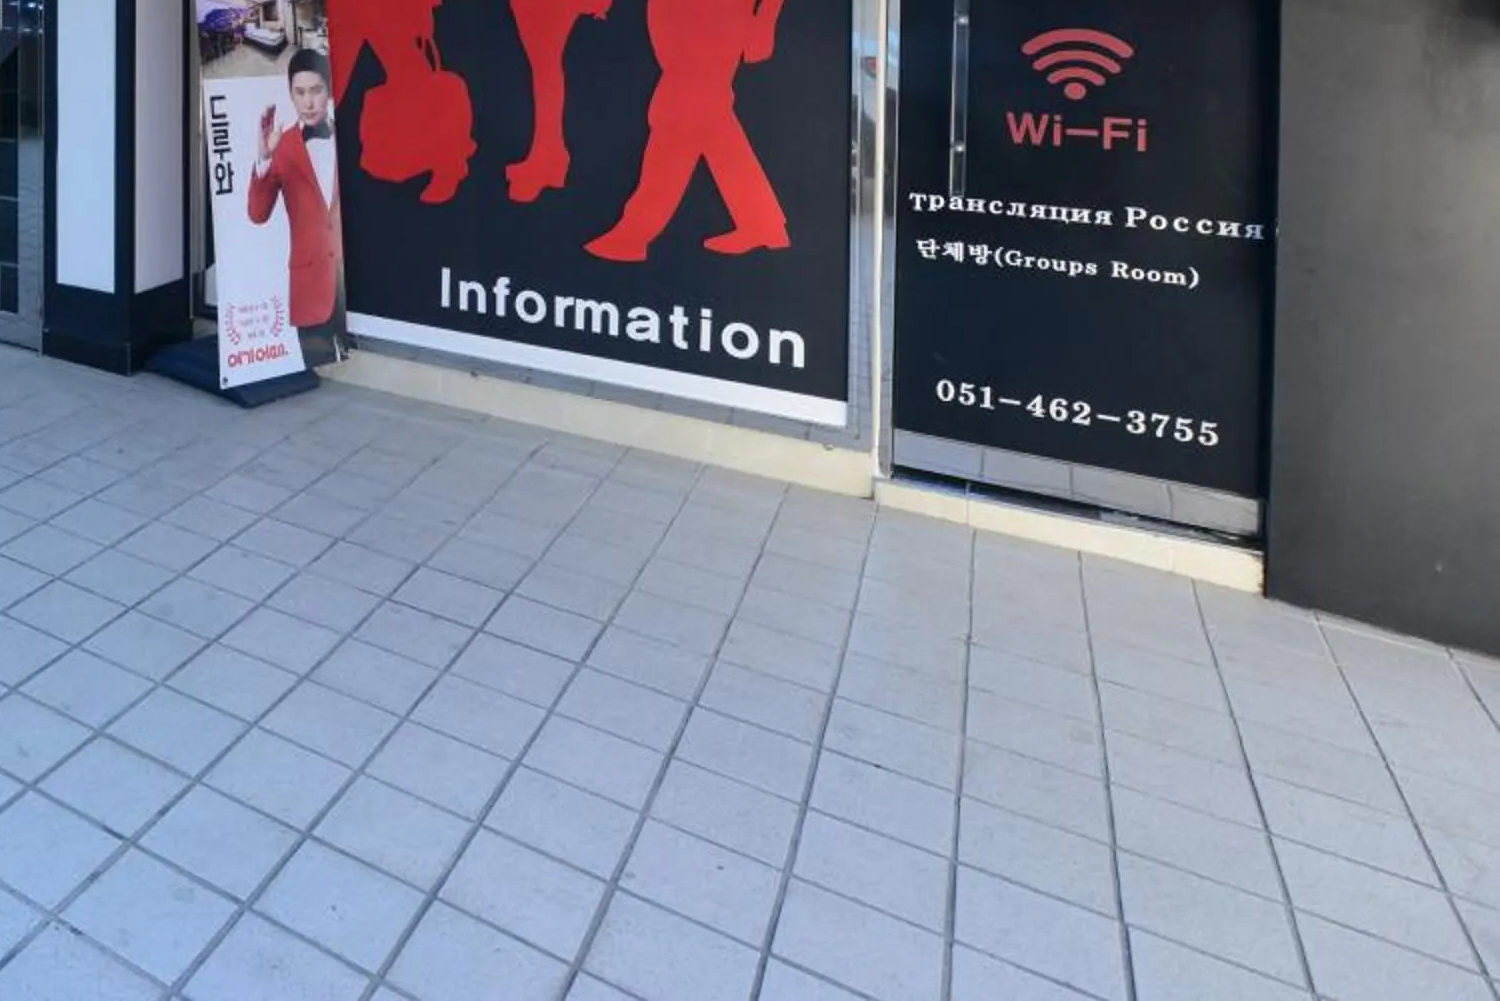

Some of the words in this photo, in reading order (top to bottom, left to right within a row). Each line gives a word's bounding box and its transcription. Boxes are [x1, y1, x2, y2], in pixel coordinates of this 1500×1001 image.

[210, 95, 234, 195] 드루와
[1006, 111, 1148, 152] Wi-Fi
[1124, 206, 1266, 241] Россия
[1110, 260, 1201, 290] Room)
[440, 266, 806, 369] Information
[935, 378, 1220, 447] 051-462-3755
